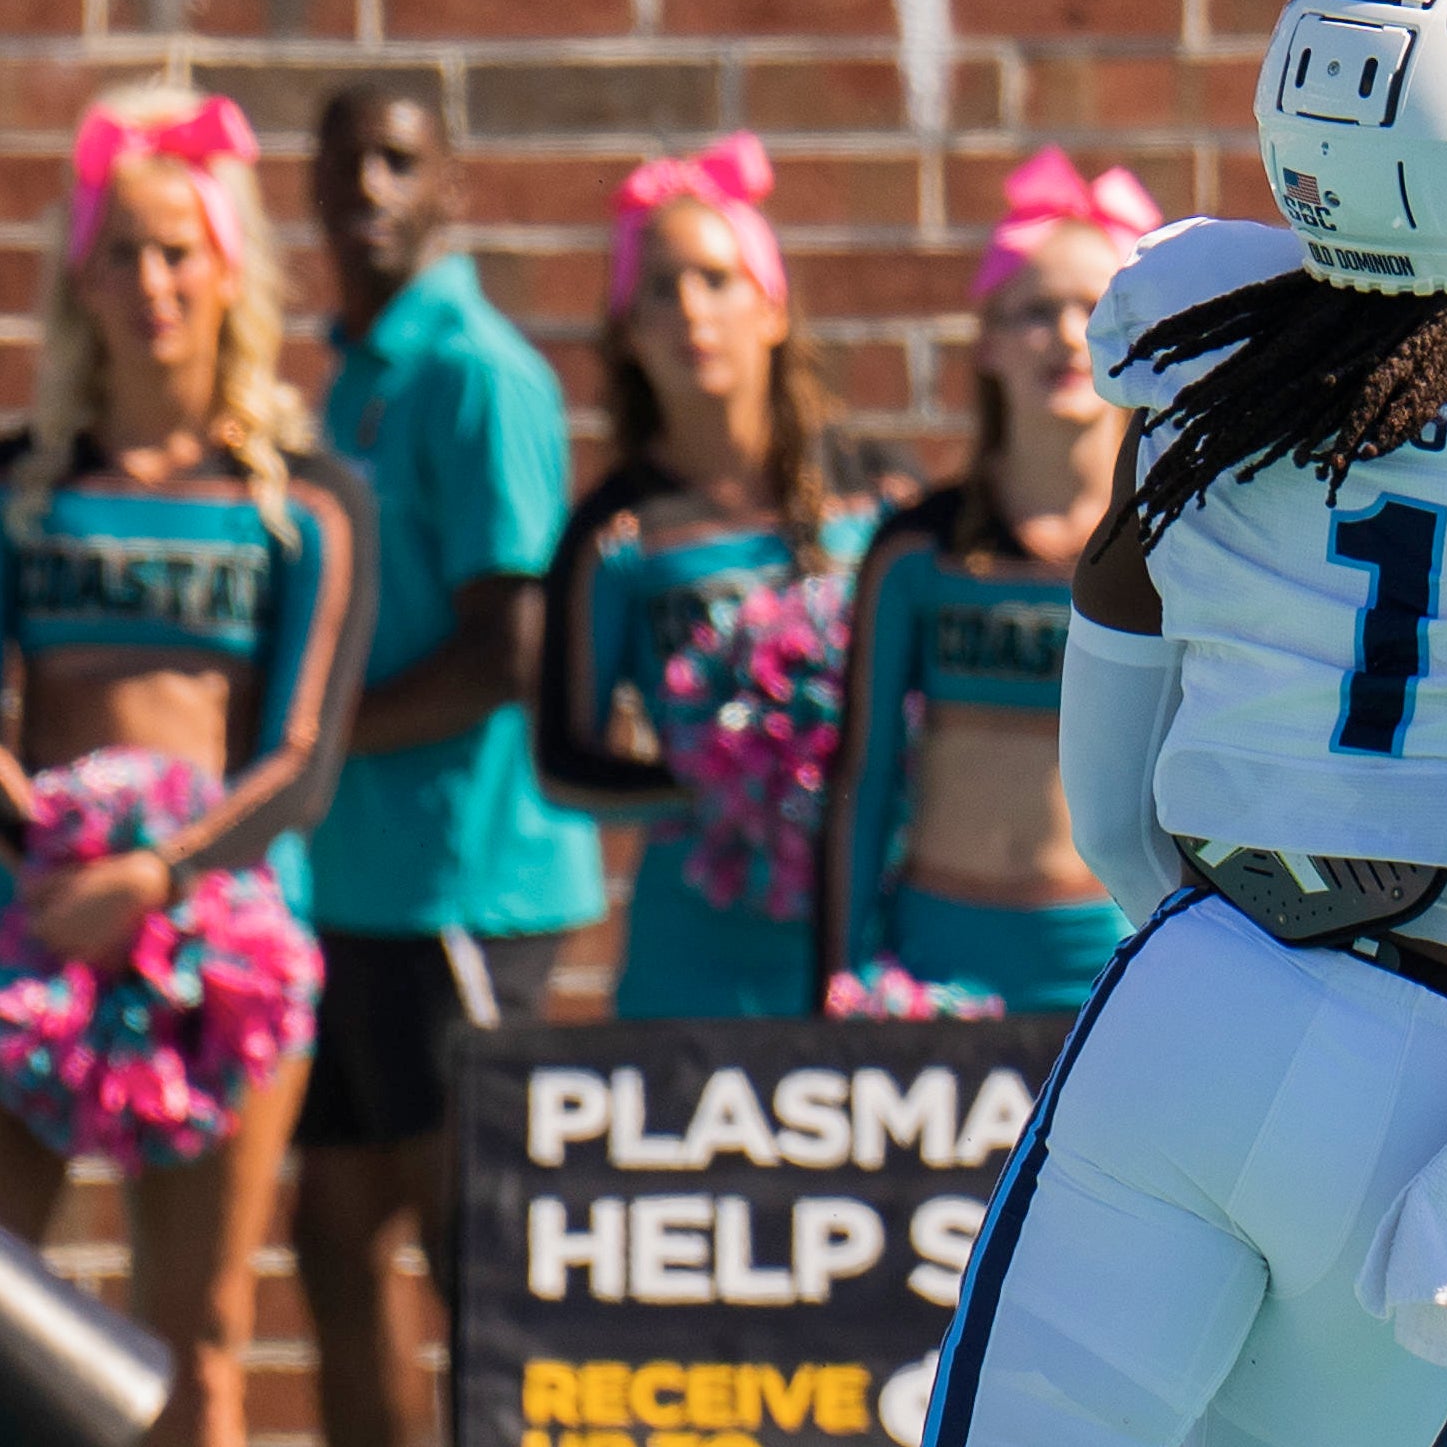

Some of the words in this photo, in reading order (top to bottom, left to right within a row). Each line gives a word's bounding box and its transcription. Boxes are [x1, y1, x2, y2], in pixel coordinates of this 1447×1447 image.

[1307, 241, 1335, 268] OLD
[1334, 248, 1416, 278] DOMINION
[526, 1065, 1036, 1172] PLASMA
[526, 1195, 886, 1305] HELP
[521, 1359, 872, 1436] RECEIVE
